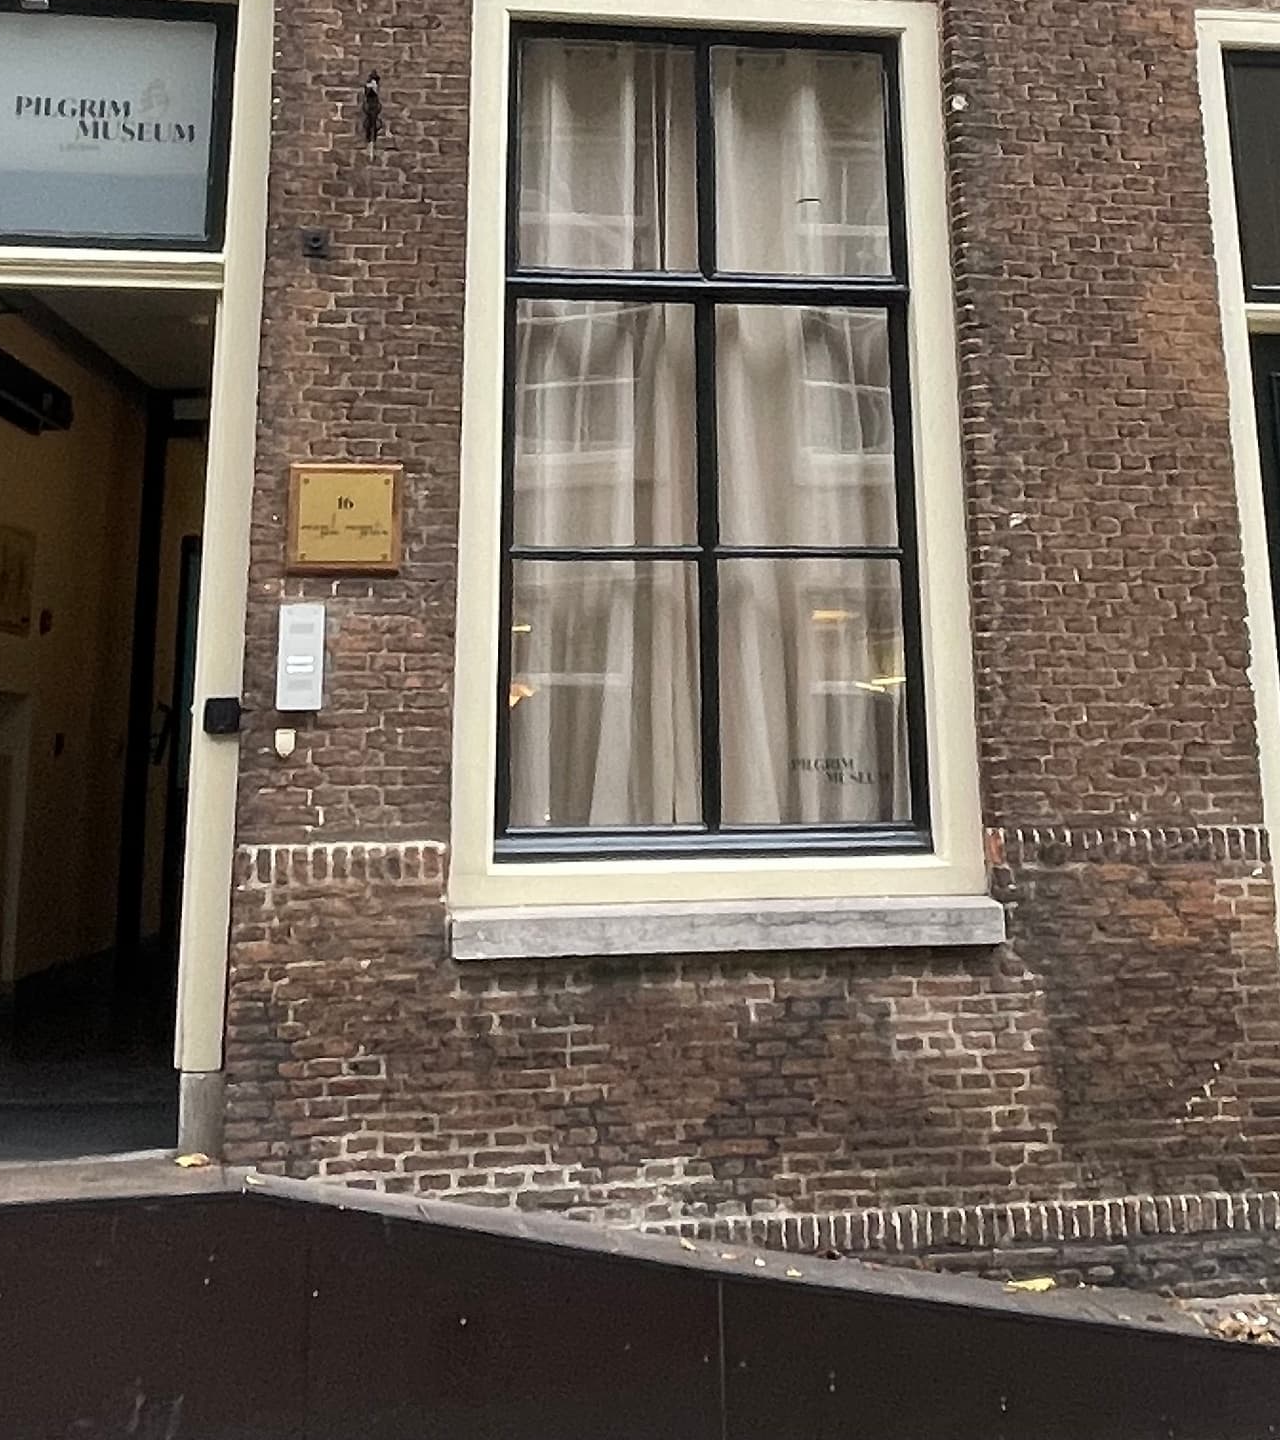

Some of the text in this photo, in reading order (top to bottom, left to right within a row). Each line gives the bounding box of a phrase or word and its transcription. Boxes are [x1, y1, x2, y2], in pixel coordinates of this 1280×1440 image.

[15, 95, 131, 119] PILGRIM
[77, 120, 196, 144] MUSEUM
[337, 496, 354, 510] 16
